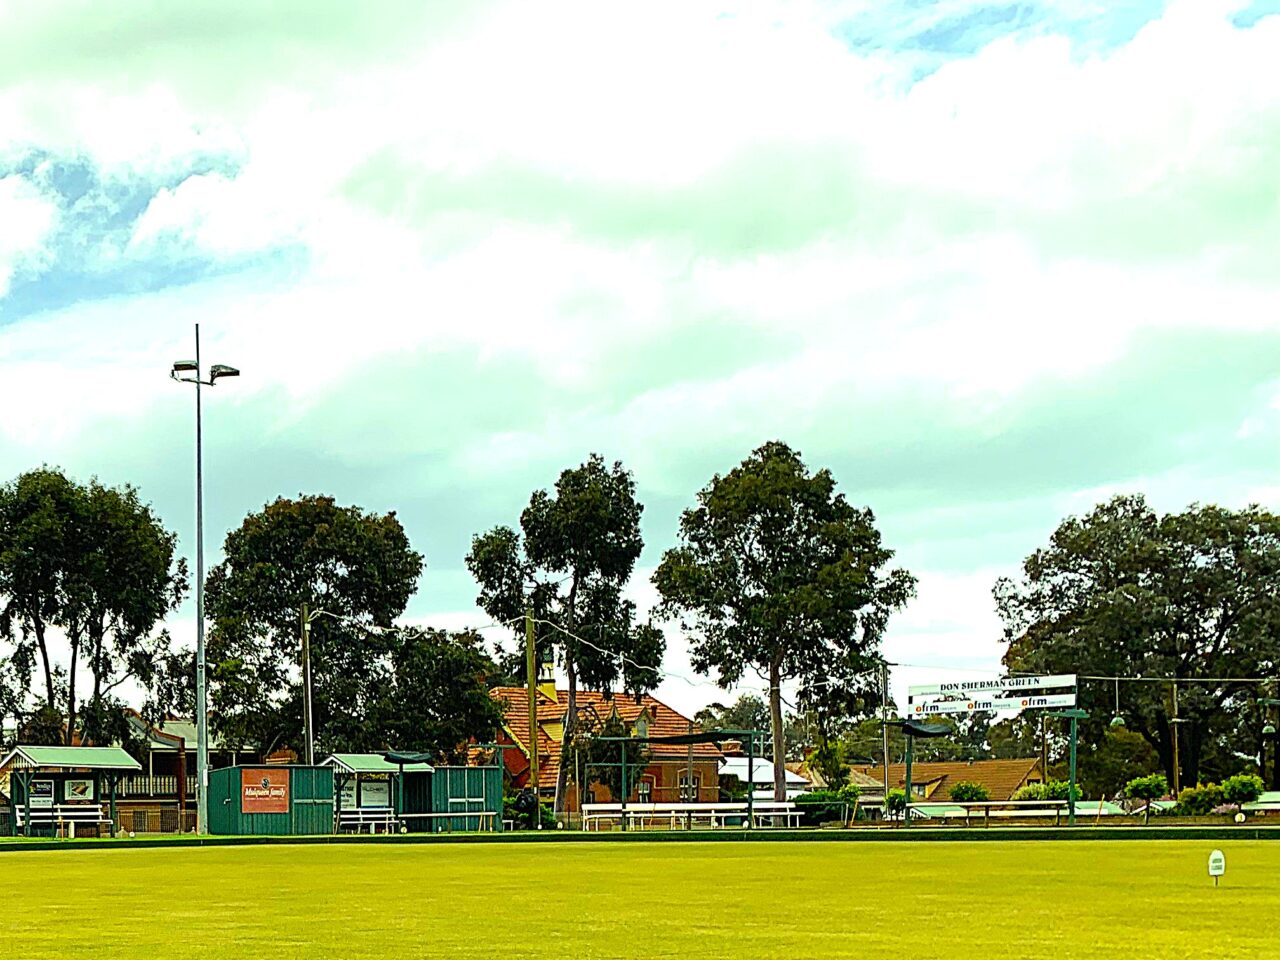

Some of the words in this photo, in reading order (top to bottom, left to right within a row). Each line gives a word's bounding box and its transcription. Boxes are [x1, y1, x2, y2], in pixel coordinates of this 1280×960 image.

[940, 683, 959, 691] DON
[961, 679, 1006, 690] SHERMAN
[1008, 677, 1040, 687] GREEN
[269, 787, 286, 798] family
